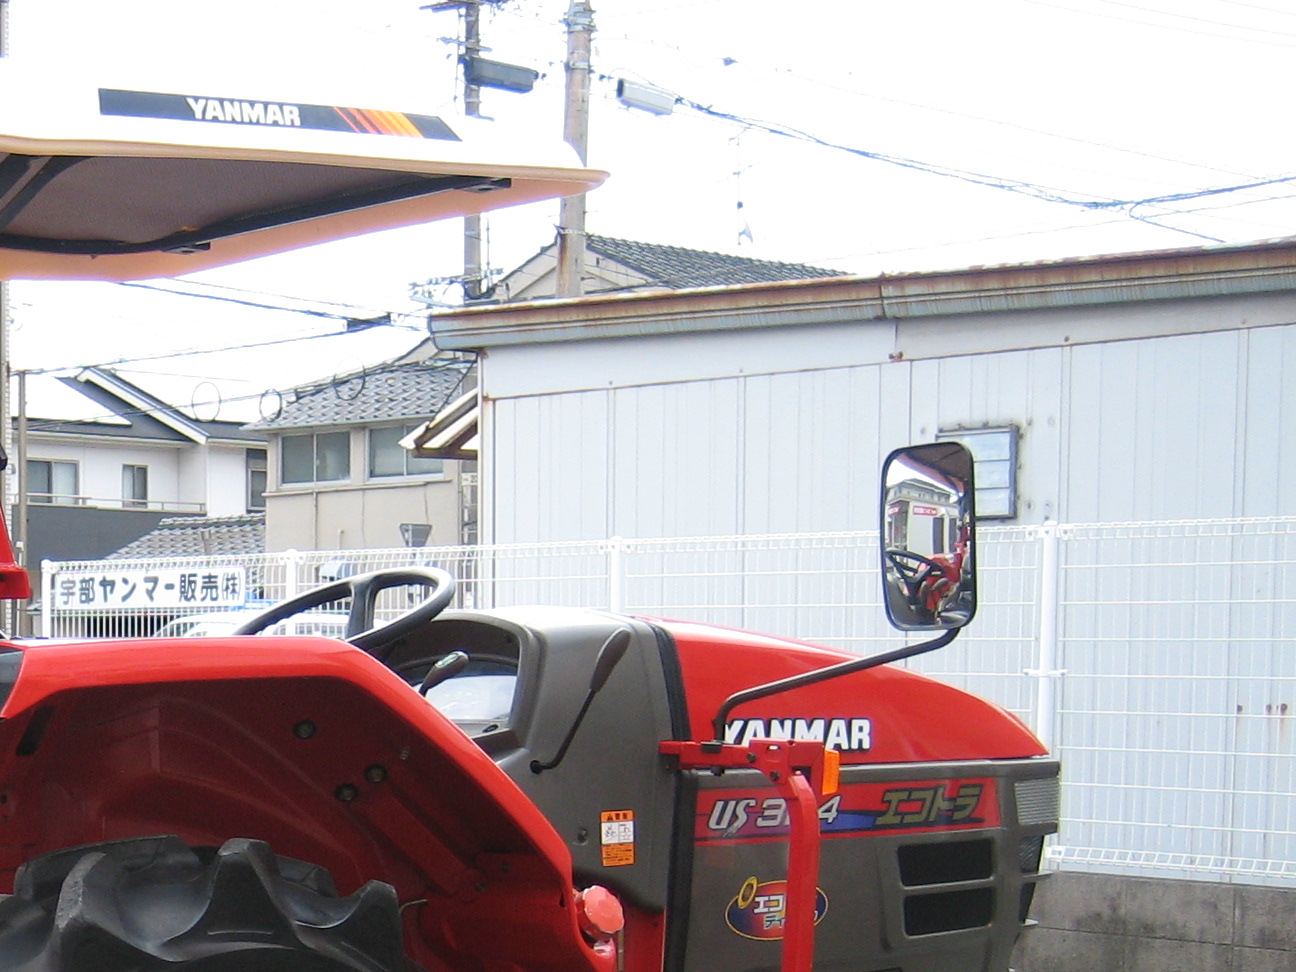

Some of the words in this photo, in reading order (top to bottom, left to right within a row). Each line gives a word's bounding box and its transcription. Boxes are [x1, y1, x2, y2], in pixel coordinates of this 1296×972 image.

[186, 97, 301, 126] YANMAR
[756, 797, 841, 827] 34
[875, 783, 983, 826] エコトラ
